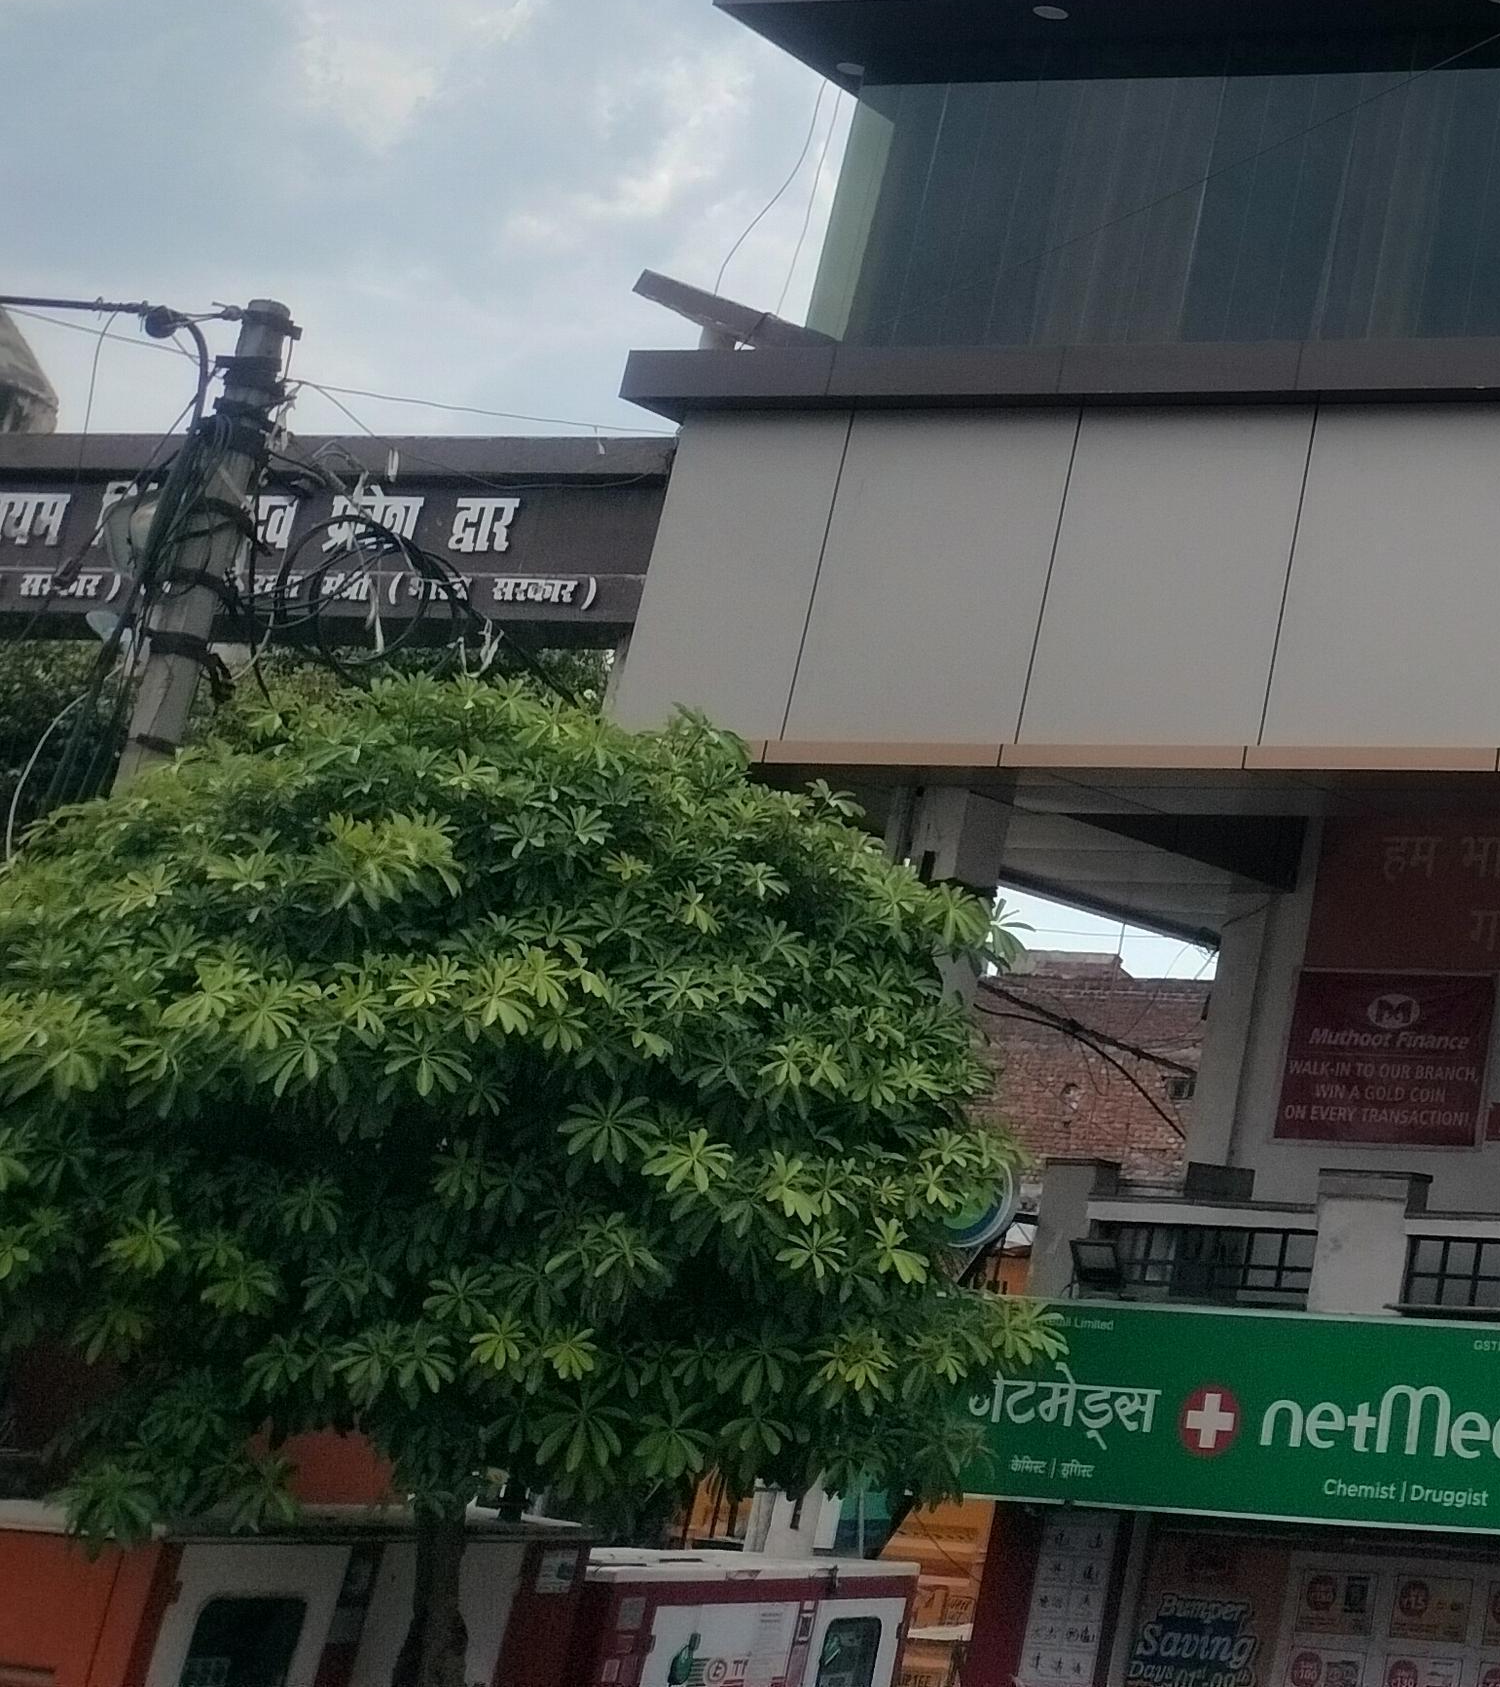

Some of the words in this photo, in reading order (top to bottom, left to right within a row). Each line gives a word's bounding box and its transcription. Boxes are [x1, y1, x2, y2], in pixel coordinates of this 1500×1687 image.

[447, 496, 521, 553] द्वार
[1383, 835, 1441, 884] हम
[1308, 1026, 1393, 1048] Muthoot
[1396, 1030, 1471, 1051] Finance
[1288, 1060, 1350, 1078] WALK-IN
[1356, 1062, 1375, 1078] TO
[1379, 1063, 1411, 1080] OUR
[1315, 1083, 1345, 1099] WIN
[1364, 1085, 1406, 1102] GOLD
[1310, 1106, 1357, 1123] EVERY
[1324, 1478, 1397, 1502] Chemist
[1410, 1483, 1490, 1510] Druggist
[1136, 1621, 1256, 1668] Saving
